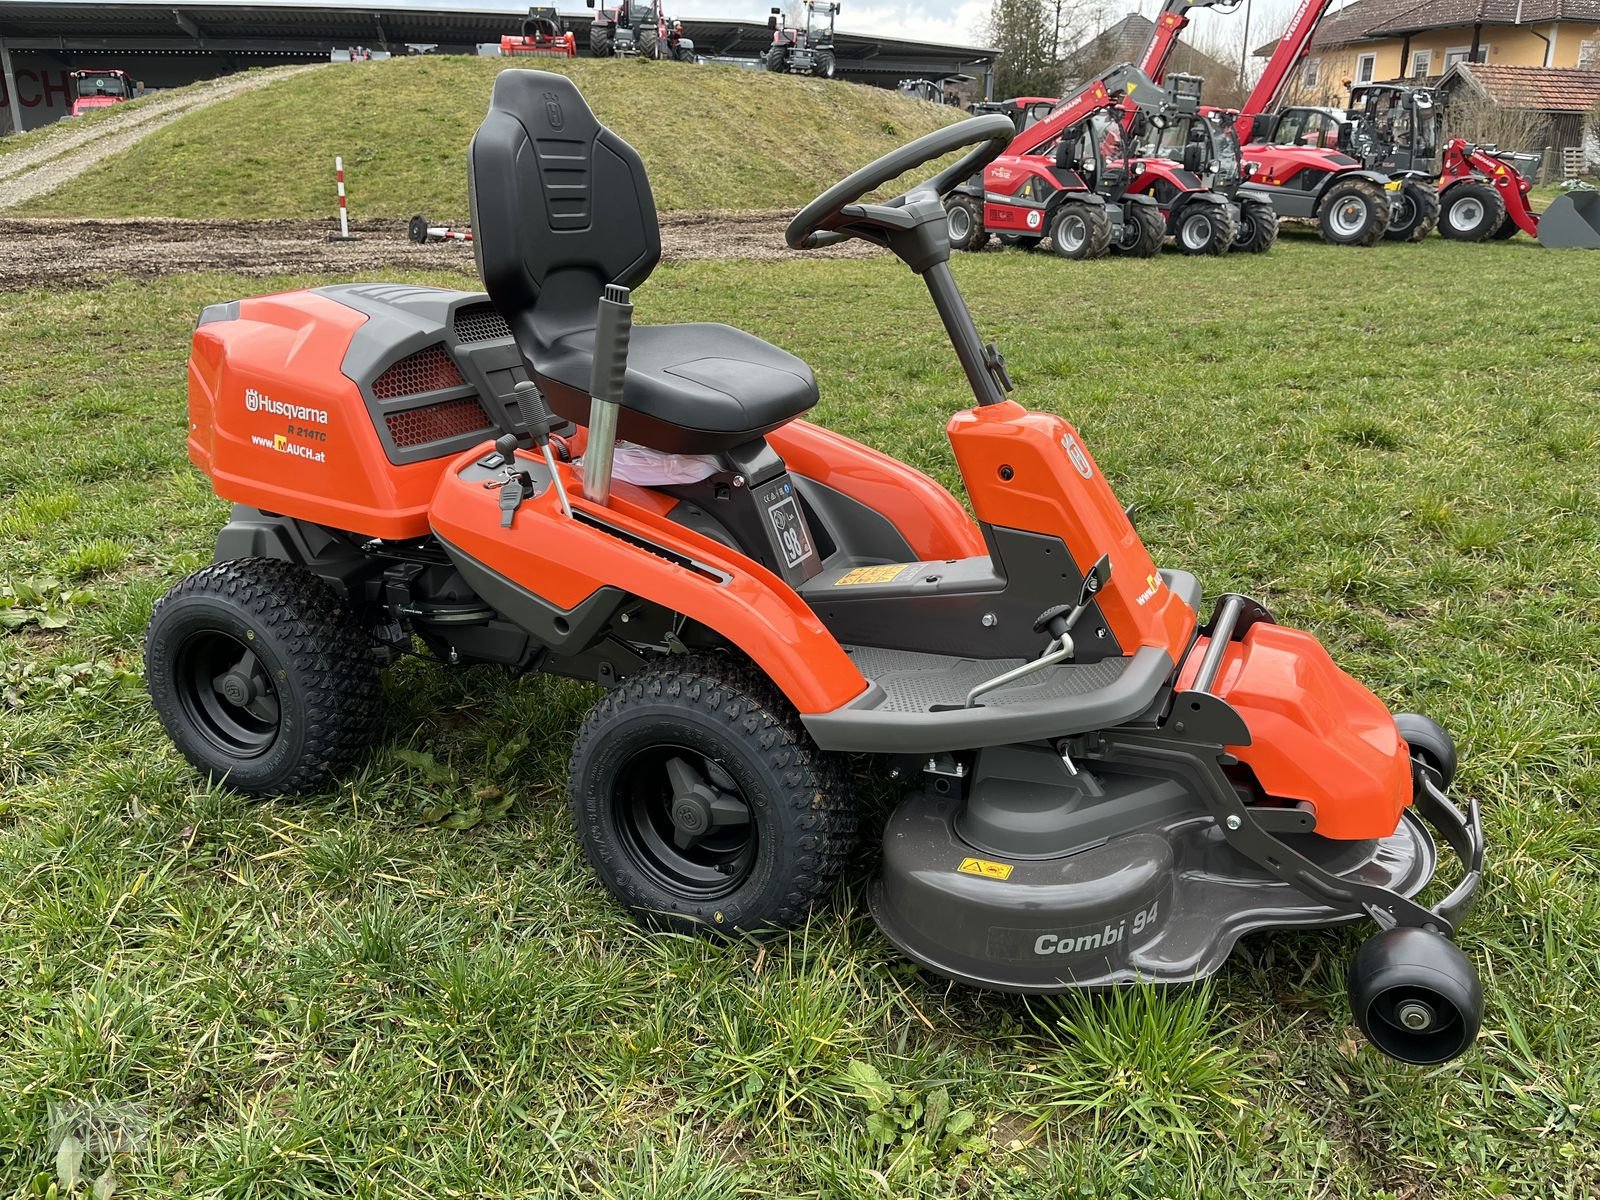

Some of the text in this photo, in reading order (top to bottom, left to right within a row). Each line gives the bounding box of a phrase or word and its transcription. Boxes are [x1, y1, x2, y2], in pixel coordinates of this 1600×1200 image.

[1029, 213, 1038, 225] 20
[259, 395, 327, 423] Husqvarna
[287, 425, 326, 442] R 214TC
[783, 527, 802, 560] 98
[1033, 900, 1160, 955] Combi 94
